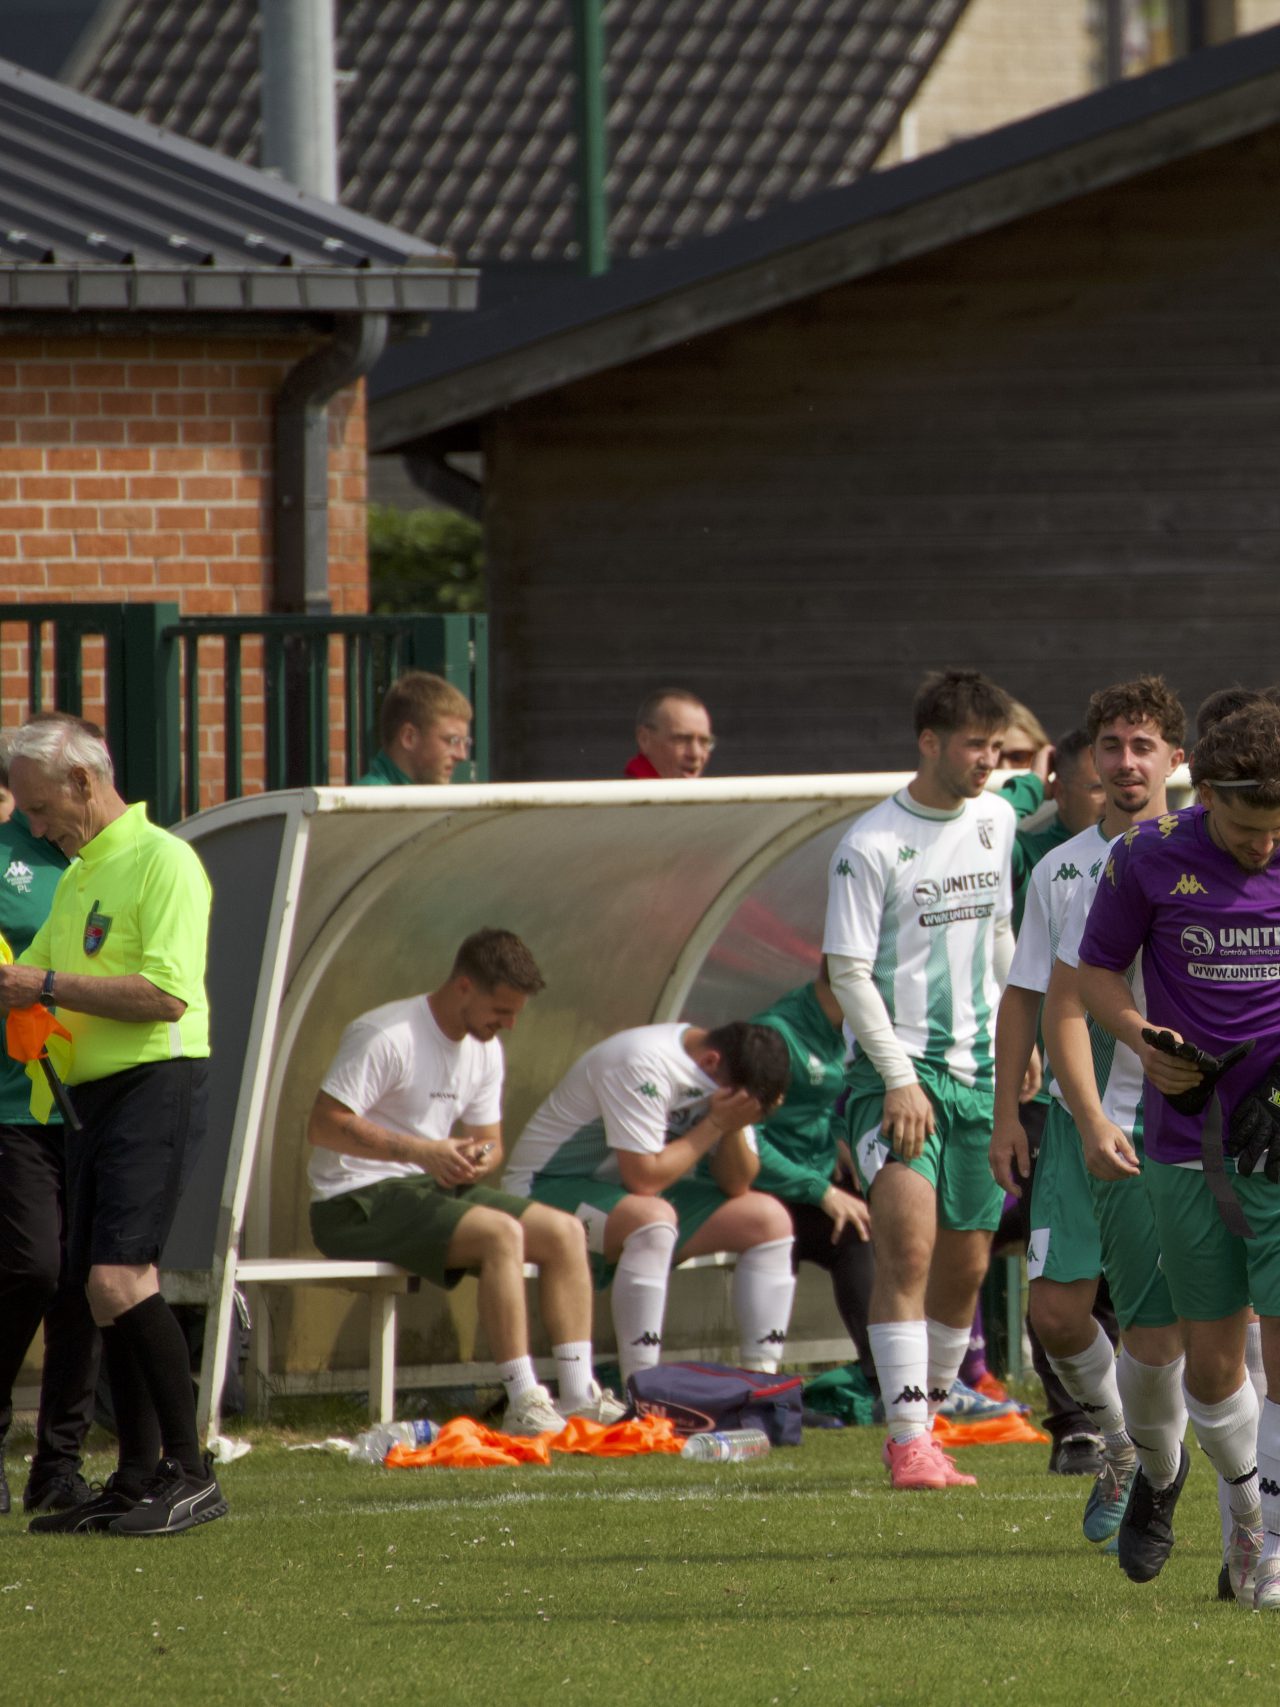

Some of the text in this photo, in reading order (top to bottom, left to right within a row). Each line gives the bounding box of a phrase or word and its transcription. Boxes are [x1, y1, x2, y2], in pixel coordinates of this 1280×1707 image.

[942, 870, 1000, 894] UNITECH
[1220, 947, 1247, 956] Contrôle
[1249, 947, 1280, 957] Technique
